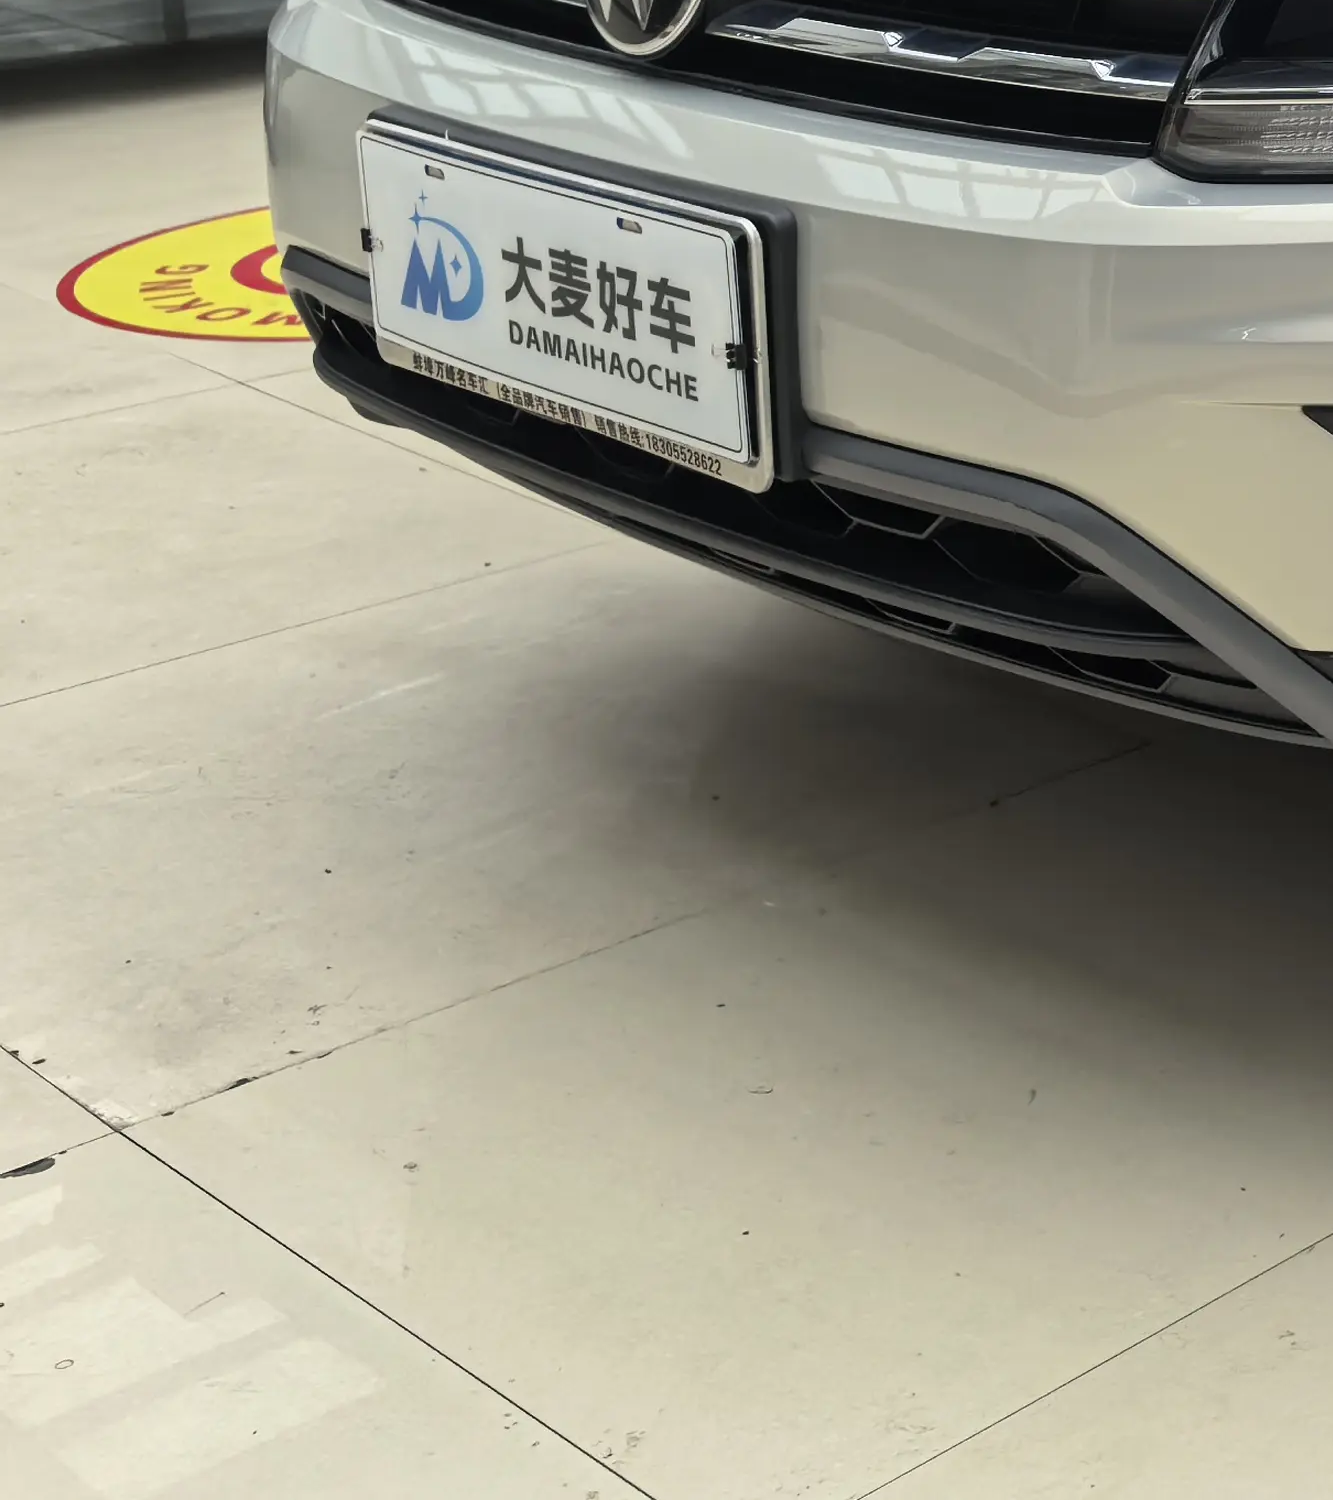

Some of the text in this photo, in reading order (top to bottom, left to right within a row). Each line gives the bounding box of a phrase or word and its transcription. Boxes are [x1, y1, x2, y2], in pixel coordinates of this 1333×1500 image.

[501, 236, 697, 355] 大麦好车
[508, 319, 700, 402] DAMAIHAOCHE
